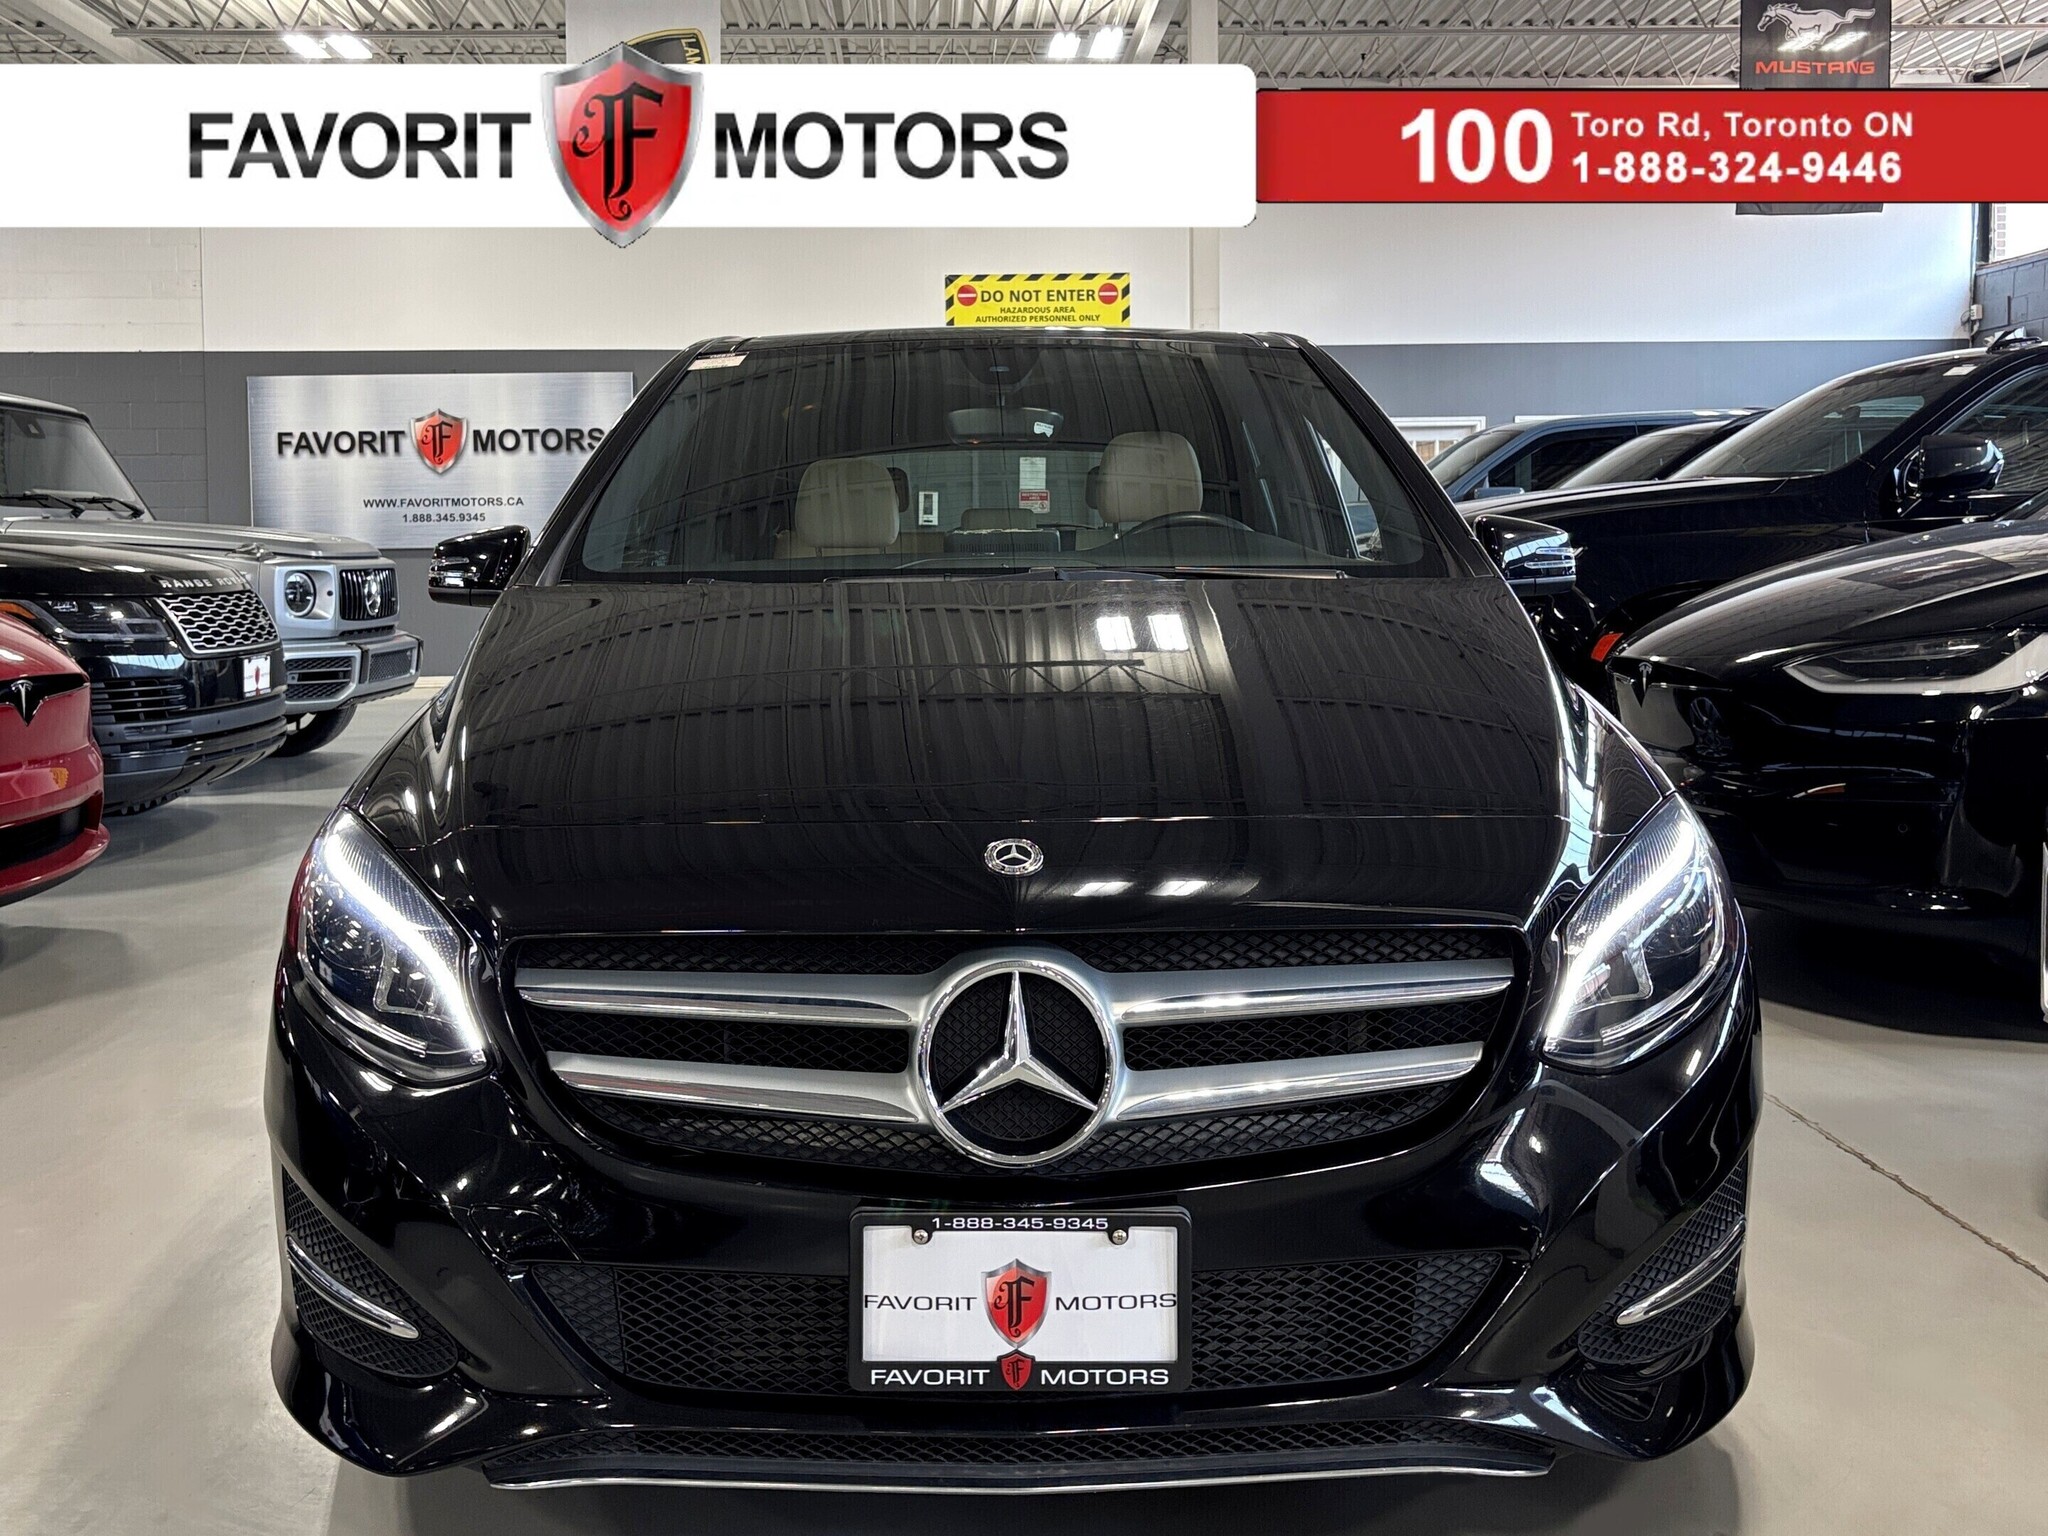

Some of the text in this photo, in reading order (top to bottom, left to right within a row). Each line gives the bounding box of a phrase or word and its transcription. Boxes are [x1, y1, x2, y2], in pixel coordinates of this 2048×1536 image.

[1755, 60, 1876, 75] MUSTANG
[980, 288, 1096, 303] DO NOT ENTER
[1079, 314, 1100, 322] ONLY
[277, 430, 406, 455] FAVORIT
[473, 427, 605, 452] MOTORS
[363, 496, 524, 508] WWW.FAVORITMOTORS.CA
[402, 513, 486, 524] 1.888.345.9345
[159, 579, 213, 588] RANGE
[932, 1217, 1109, 1230] 1-888-345-9345
[864, 1294, 977, 1311] FAVORIT
[1055, 1293, 1178, 1311] MOTORS
[871, 1369, 990, 1386] FAVORIT
[1041, 1369, 1169, 1386] MOTORS
